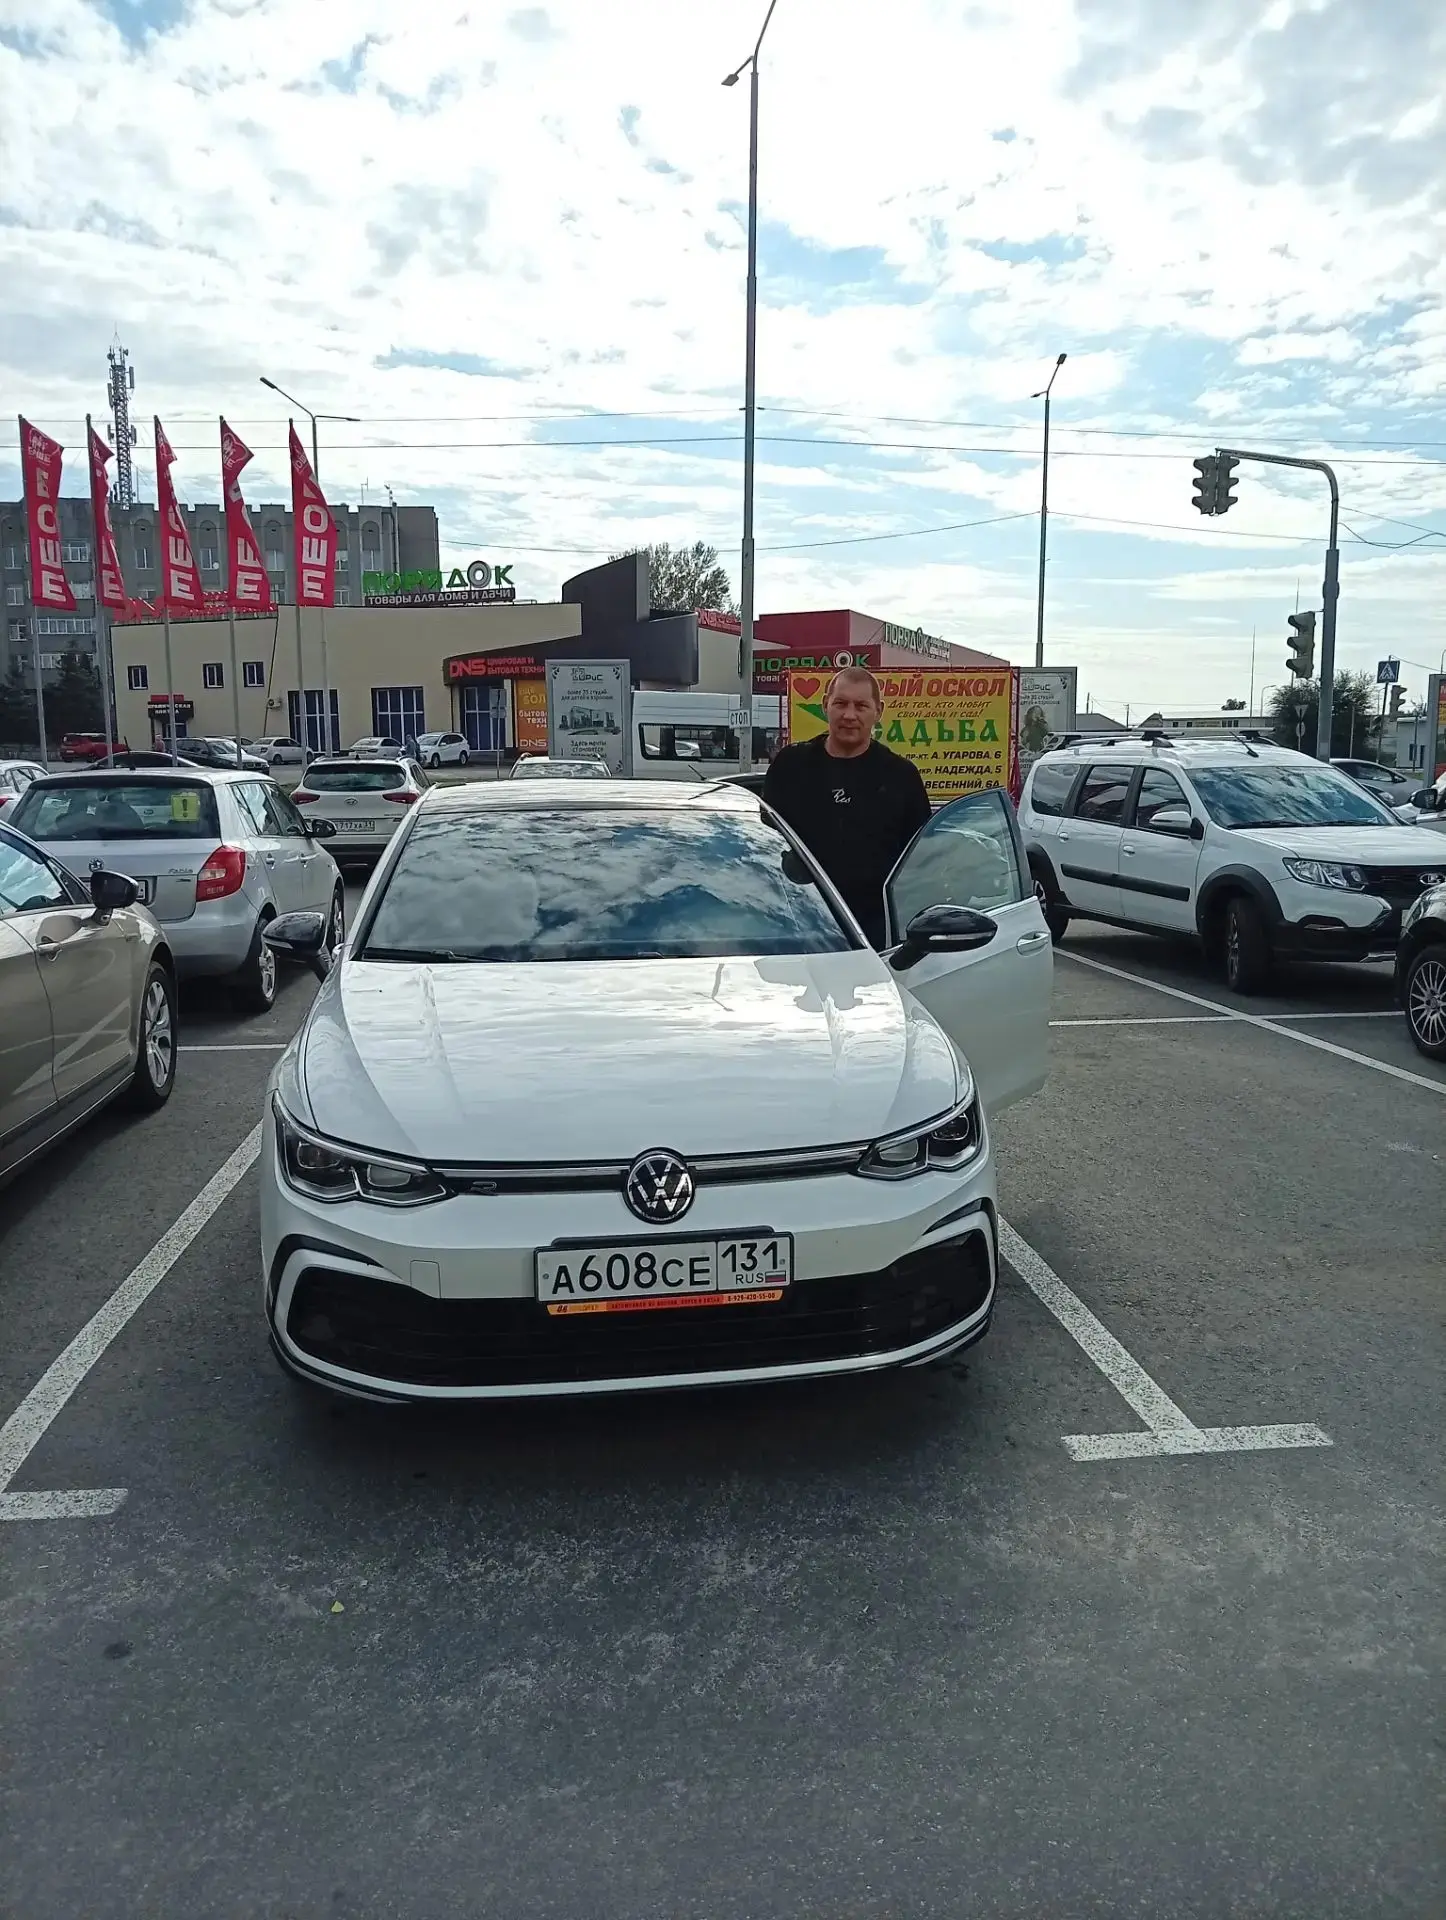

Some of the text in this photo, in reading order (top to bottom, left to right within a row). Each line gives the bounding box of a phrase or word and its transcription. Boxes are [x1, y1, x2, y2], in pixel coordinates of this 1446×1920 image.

[362, 560, 513, 594] ПОРЯДОК
[414, 593, 435, 603] для
[438, 592, 469, 602] дома
[481, 588, 511, 599] дачи
[885, 622, 929, 654] ПОРЯДОК
[753, 649, 871, 672] ПОРЯДОК
[449, 659, 487, 678] DNS
[927, 678, 1006, 697] ОСКОЛ
[888, 700, 909, 709] Для
[935, 701, 954, 709] кто
[956, 700, 992, 709] любит
[730, 711, 748, 726] СТОП
[924, 711, 946, 719] дом
[520, 739, 547, 747] DNS
[994, 750, 1002, 759] 6
[994, 765, 1002, 774] 5
[721, 1240, 778, 1273] 131
[735, 1271, 765, 1286] RUS
